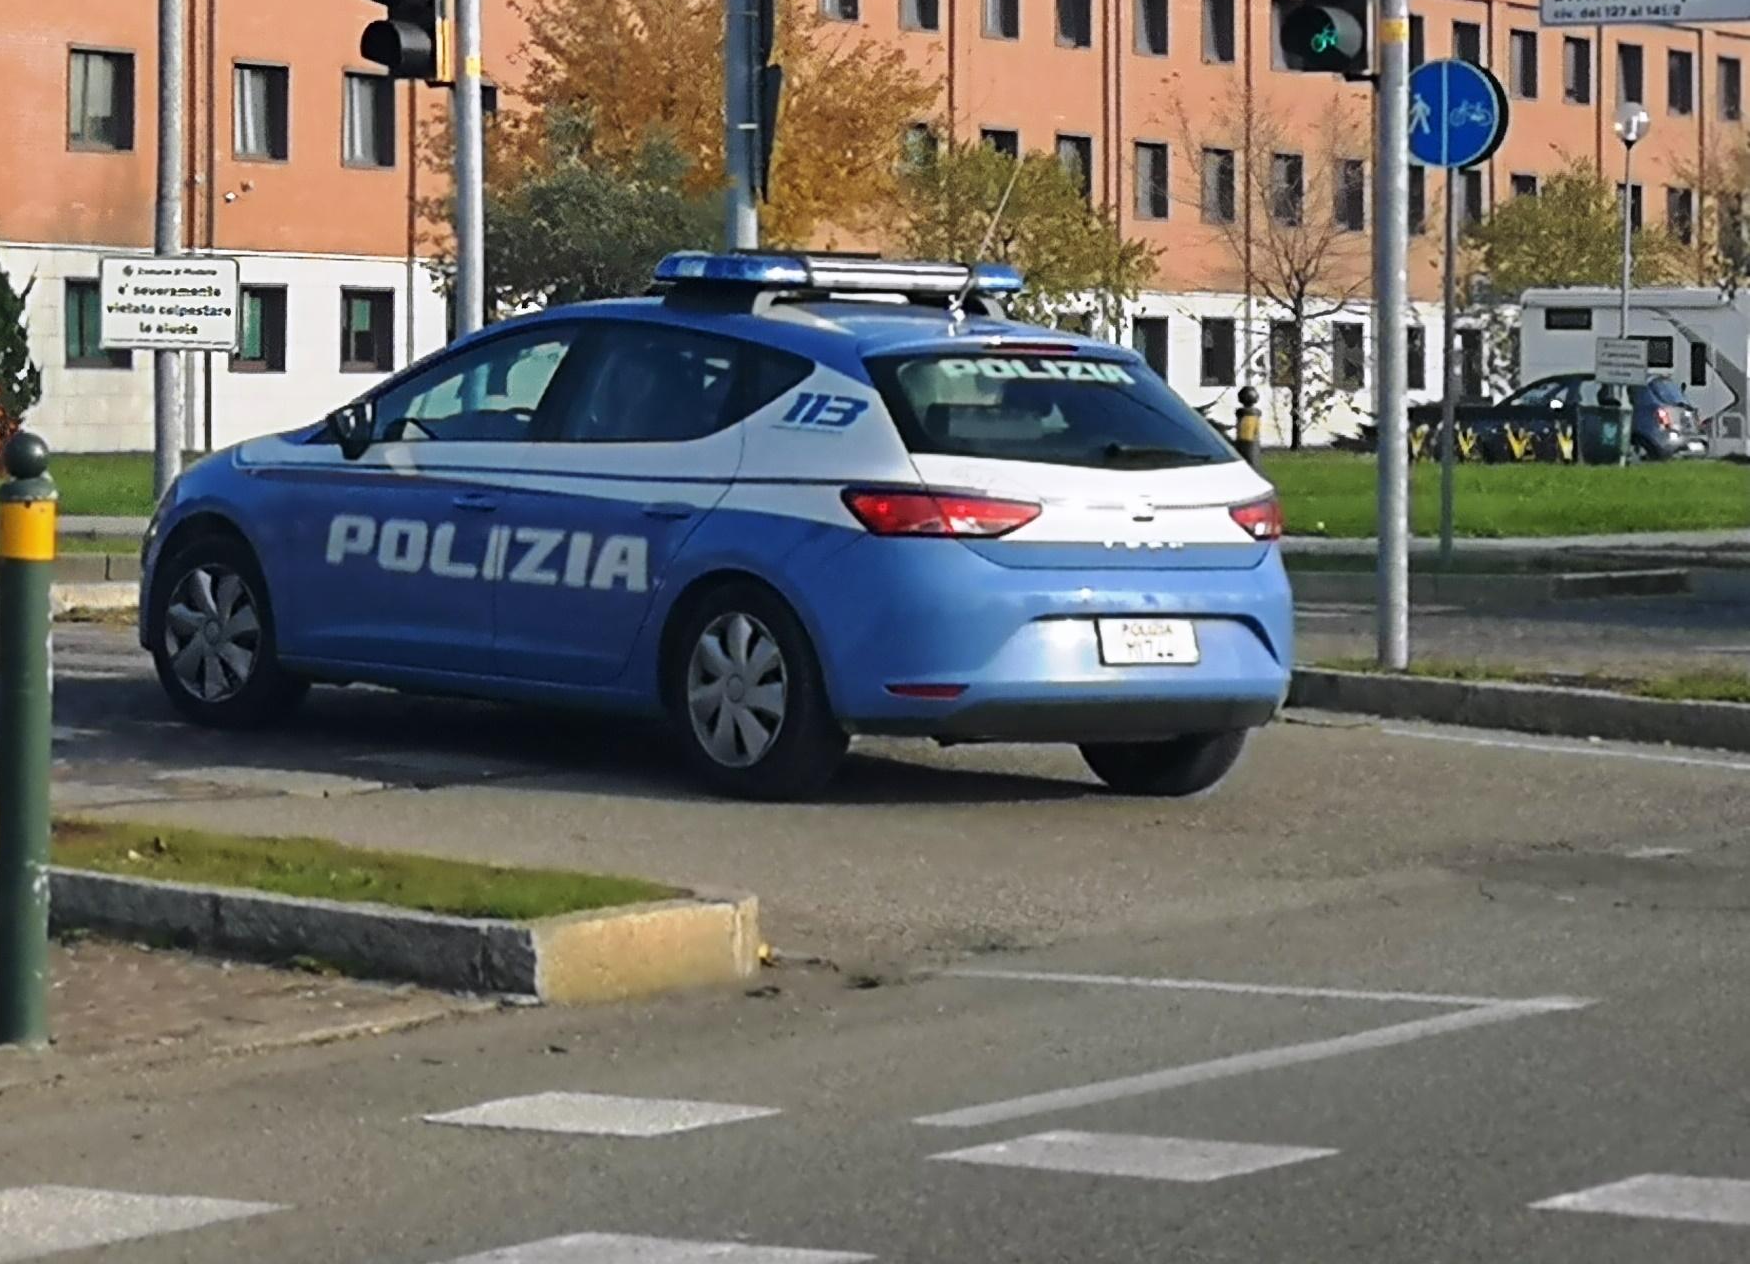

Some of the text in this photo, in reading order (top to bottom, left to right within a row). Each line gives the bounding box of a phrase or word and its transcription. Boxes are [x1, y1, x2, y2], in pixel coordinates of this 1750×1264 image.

[1604, 5, 1627, 17] 127
[107, 302, 155, 314] vietato
[939, 359, 1135, 385] POLIZIA
[783, 392, 869, 427] 113
[326, 514, 649, 592] POLIZIA
